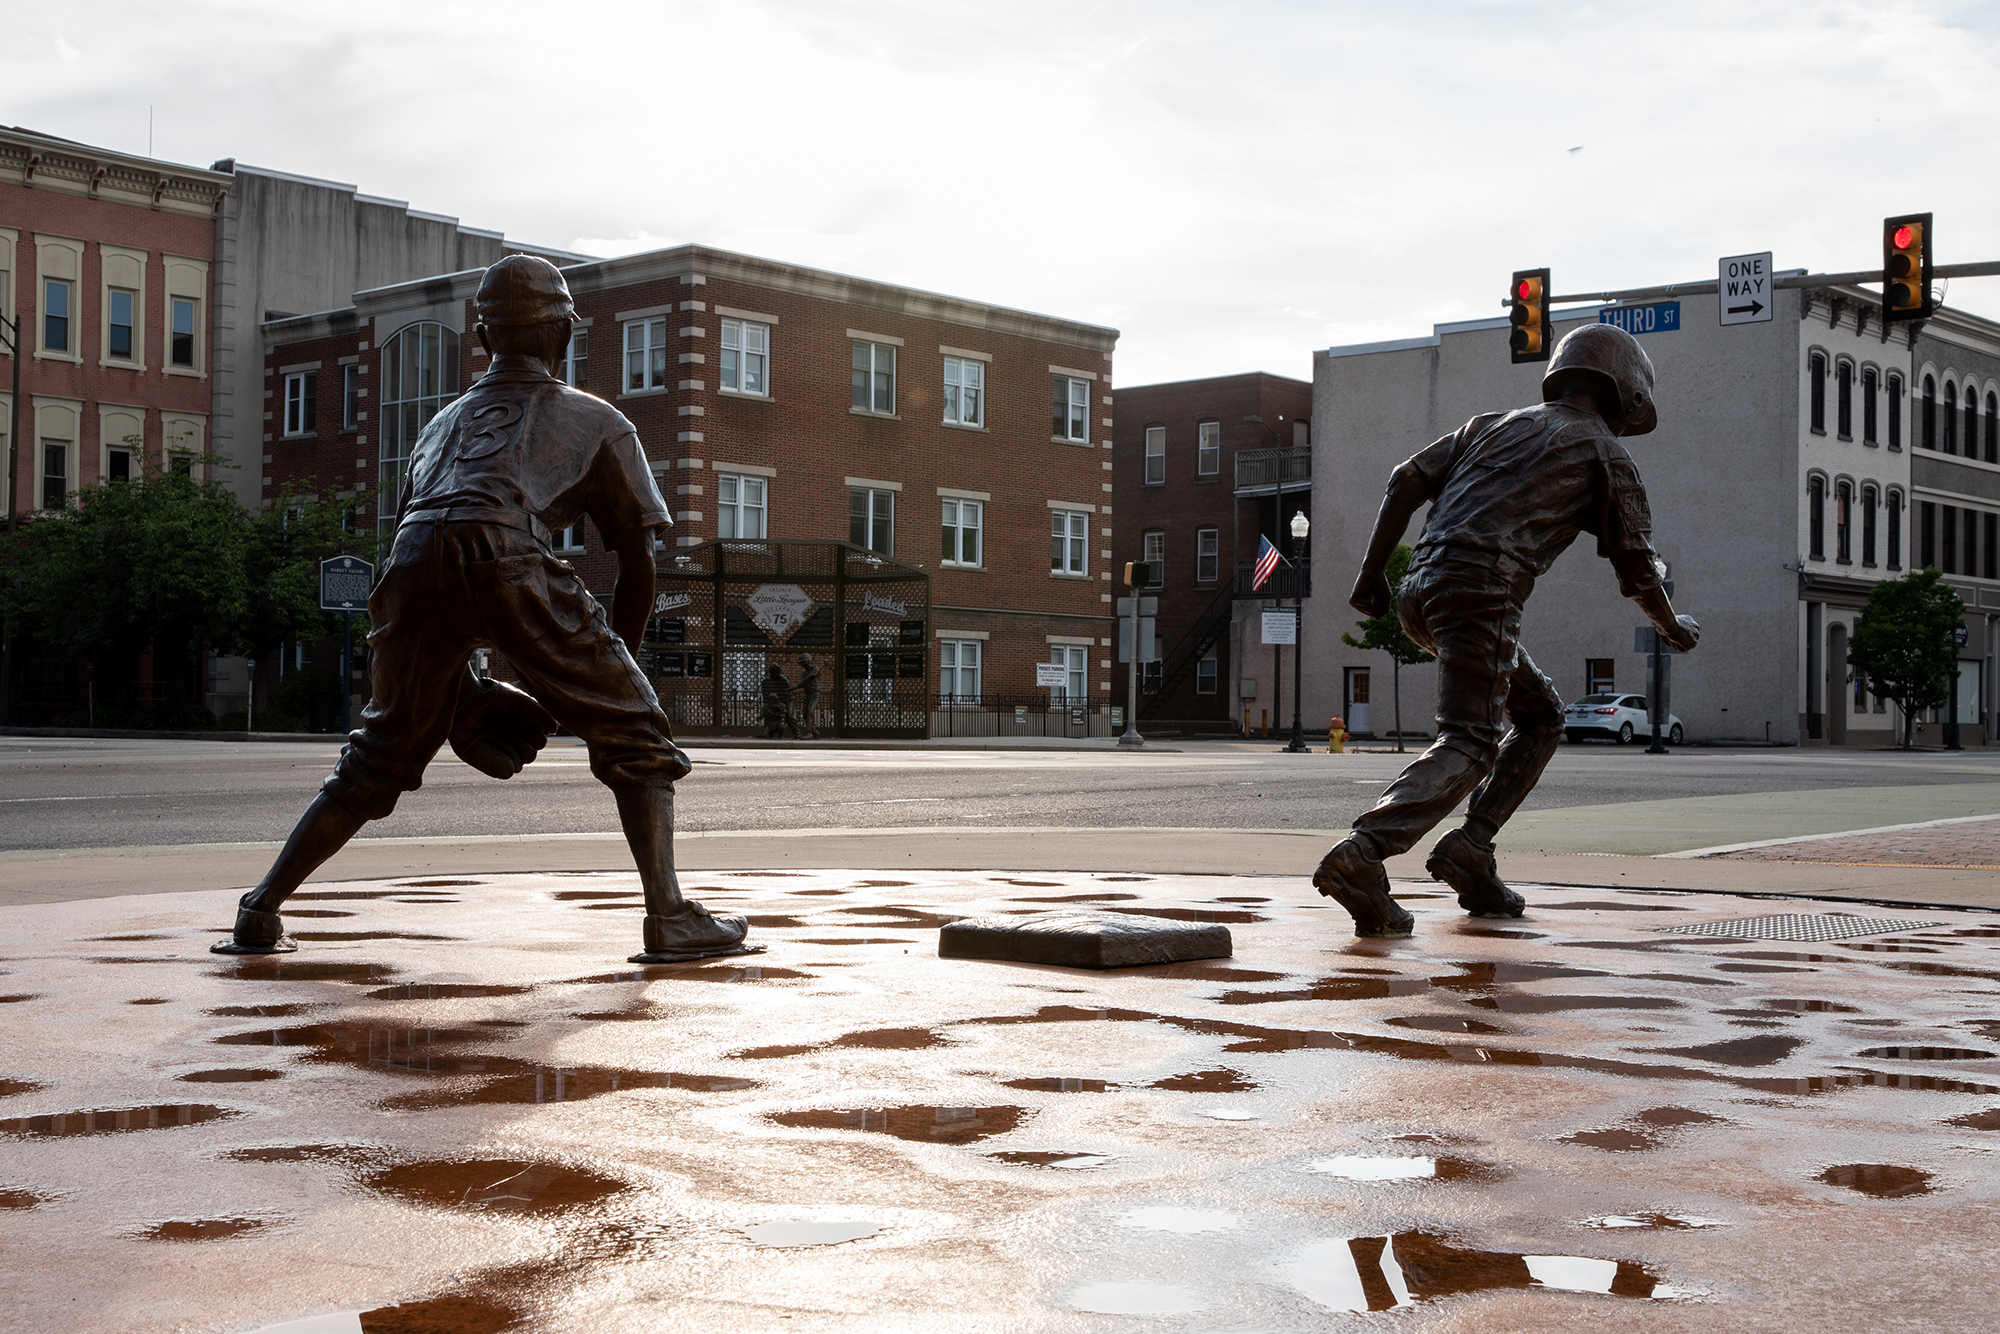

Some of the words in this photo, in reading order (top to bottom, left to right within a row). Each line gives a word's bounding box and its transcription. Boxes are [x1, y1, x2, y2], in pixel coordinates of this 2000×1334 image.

[1728, 259, 1763, 278] ONE
[1727, 278, 1764, 297] WAY
[1603, 307, 1656, 333] THIRD
[1663, 310, 1675, 324] ST
[453, 401, 523, 460] 3
[1623, 491, 1642, 514] 50
[654, 592, 692, 614] Bases
[753, 593, 776, 605] Little
[776, 594, 807, 606] League
[862, 590, 908, 616] Loaded
[772, 613, 787, 624] 75
